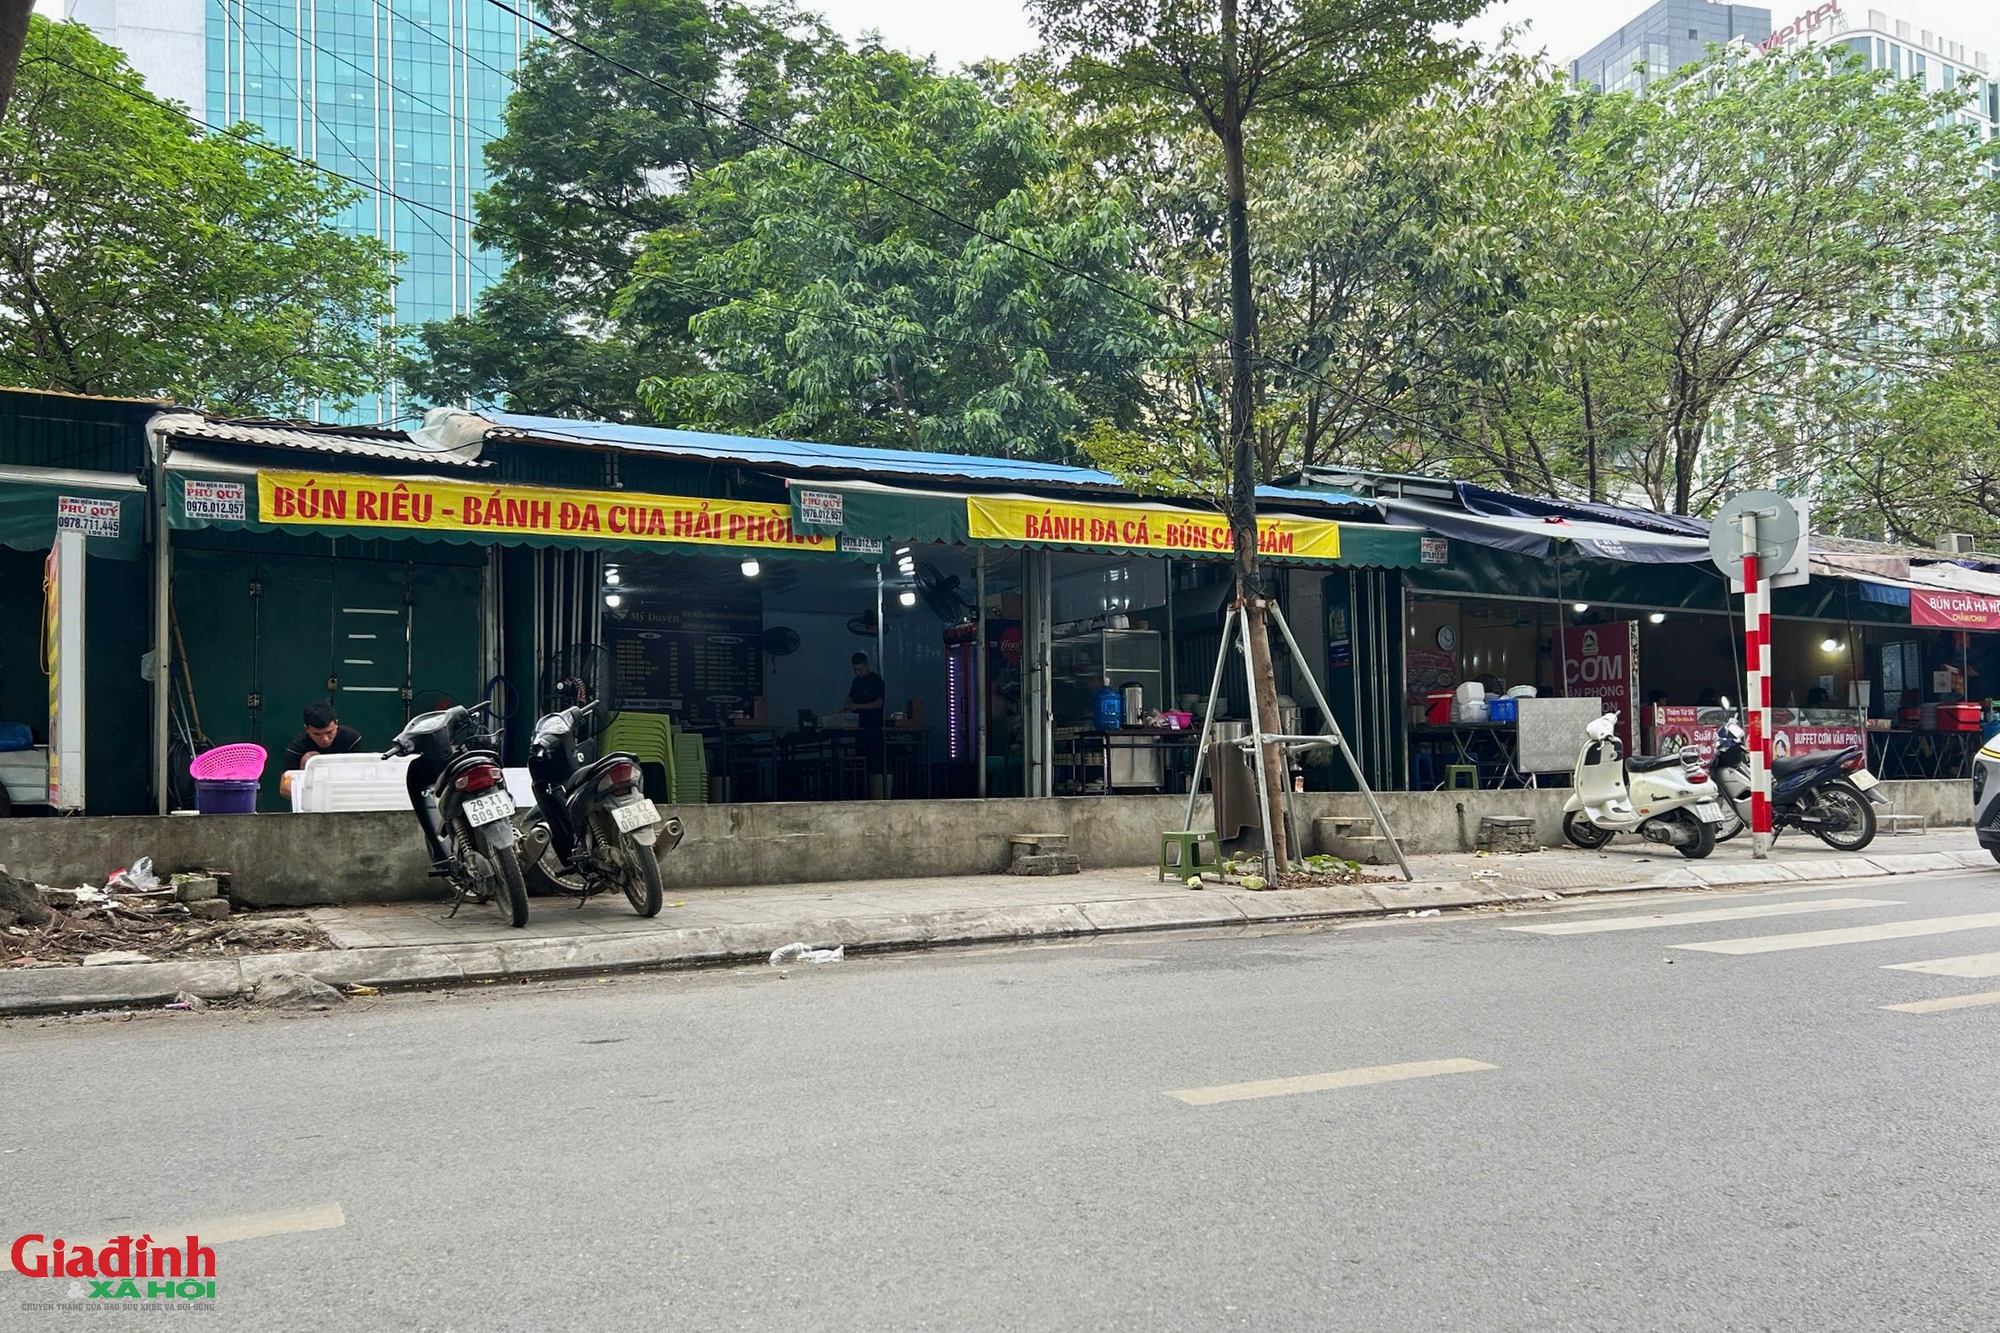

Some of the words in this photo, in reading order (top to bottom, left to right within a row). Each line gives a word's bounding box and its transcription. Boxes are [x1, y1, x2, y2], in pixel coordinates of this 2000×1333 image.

[186, 501, 244, 514] 0976.012.957
[274, 478, 347, 519] BÚN
[356, 483, 433, 523] RIÊU
[462, 489, 551, 529] BÁNH
[558, 501, 601, 532] ĐA
[608, 505, 667, 536] CUA
[673, 501, 721, 539] HẢI
[58, 516, 119, 532] 0978.711.445
[1025, 508, 1085, 541] BÁNH
[1090, 518, 1118, 543] ĐA
[1122, 515, 1149, 545] CÁ
[1166, 518, 1207, 548] BÚN
[1930, 596, 1951, 610] BÚN
[1952, 596, 1973, 612] CHẢ
[1974, 598, 1989, 612] HÀ
[1563, 654, 1623, 684] CƠM
[1584, 684, 1625, 697] PHÒNG
[1694, 729, 1712, 741] Suất
[1794, 732, 1817, 745] BUFFET
[1818, 731, 1832, 745] CƠM
[1832, 731, 1845, 745] VĂN
[470, 794, 502, 812] 29-X1
[620, 802, 649, 819] 29-X2
[471, 803, 511, 825] 909.63
[621, 811, 657, 831] 067.95
